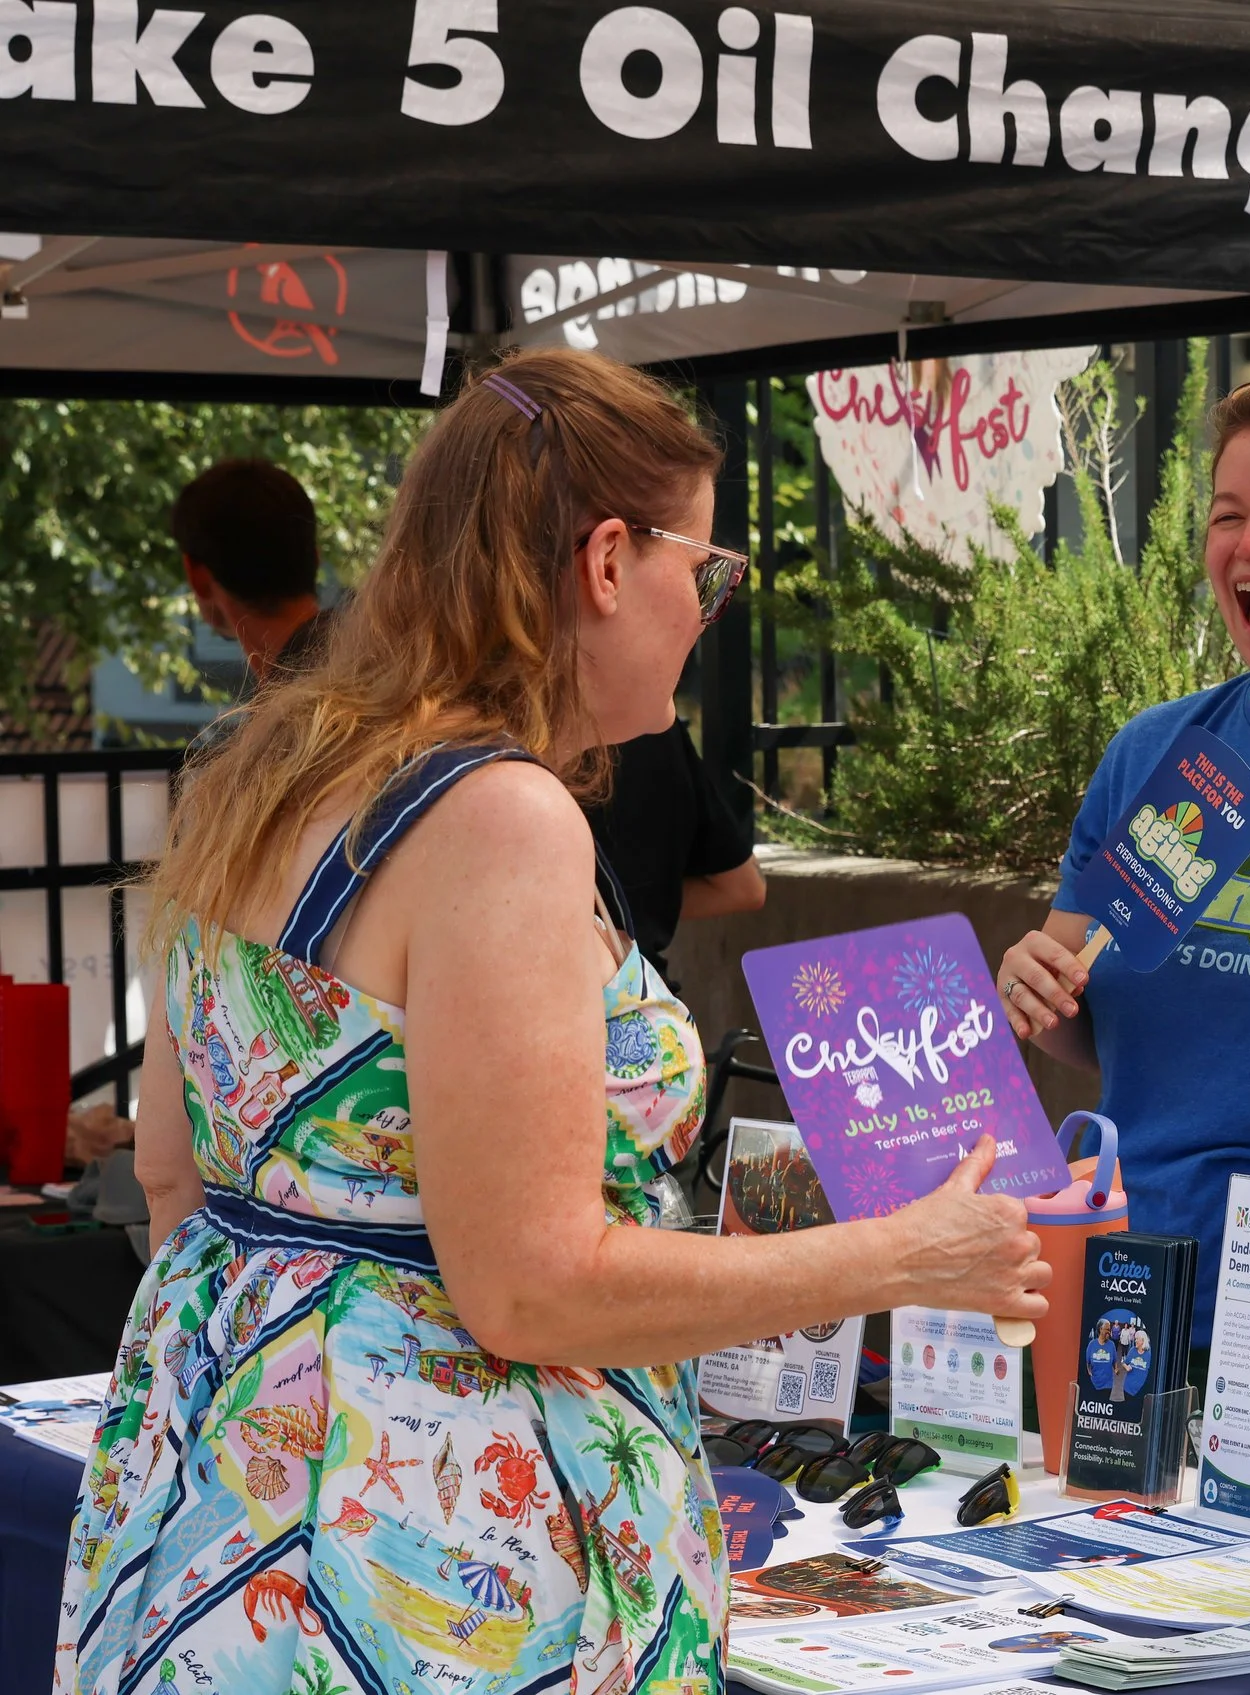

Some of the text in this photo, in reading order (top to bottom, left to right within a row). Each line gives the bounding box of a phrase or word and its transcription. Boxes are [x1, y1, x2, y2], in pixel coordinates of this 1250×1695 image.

[400, 0, 505, 127] 5
[580, 6, 814, 149] Oil
[1194, 752, 1244, 806] THIS IS THE
[1178, 759, 1245, 830] PLACE FOR YOU
[1130, 805, 1216, 900] aging
[1116, 842, 1154, 887] EVERYBODY'S
[1152, 883, 1175, 910] DOING
[1173, 905, 1183, 916] IT
[1112, 898, 1131, 922] ACCA
[1131, 883, 1179, 935] WWW.ACCAGING.ORG
[843, 1066, 878, 1087] TERRAPIN
[845, 1089, 994, 1137] July 16, 2022
[875, 1120, 982, 1151] Terrapin Beer Co.
[1099, 1252, 1151, 1280] Center
[1115, 1250, 1128, 1261] the
[1101, 1278, 1146, 1295] at ACCA
[705, 1360, 739, 1371] ATHENS, GA
[784, 1362, 804, 1370] REGISTER:
[815, 1350, 840, 1358] VOLUNTEER:
[898, 1402, 1013, 1427] THRIVE CONNECT CREATE TRAVEL LEARN
[1080, 1401, 1113, 1416] AGING
[388, 1416, 442, 1437] La Mer
[1077, 1415, 1143, 1436] REIMAGINED.
[1074, 1452, 1104, 1464] Possibility.
[1122, 1459, 1136, 1468] here.
[1075, 1441, 1133, 1456] Connection. Support.
[479, 1526, 538, 1562] La Plage
[732, 1530, 749, 1543] THIS
[933, 1616, 996, 1630] NEW
[179, 1649, 212, 1685] Salut
[411, 1660, 476, 1689] St Tropez
